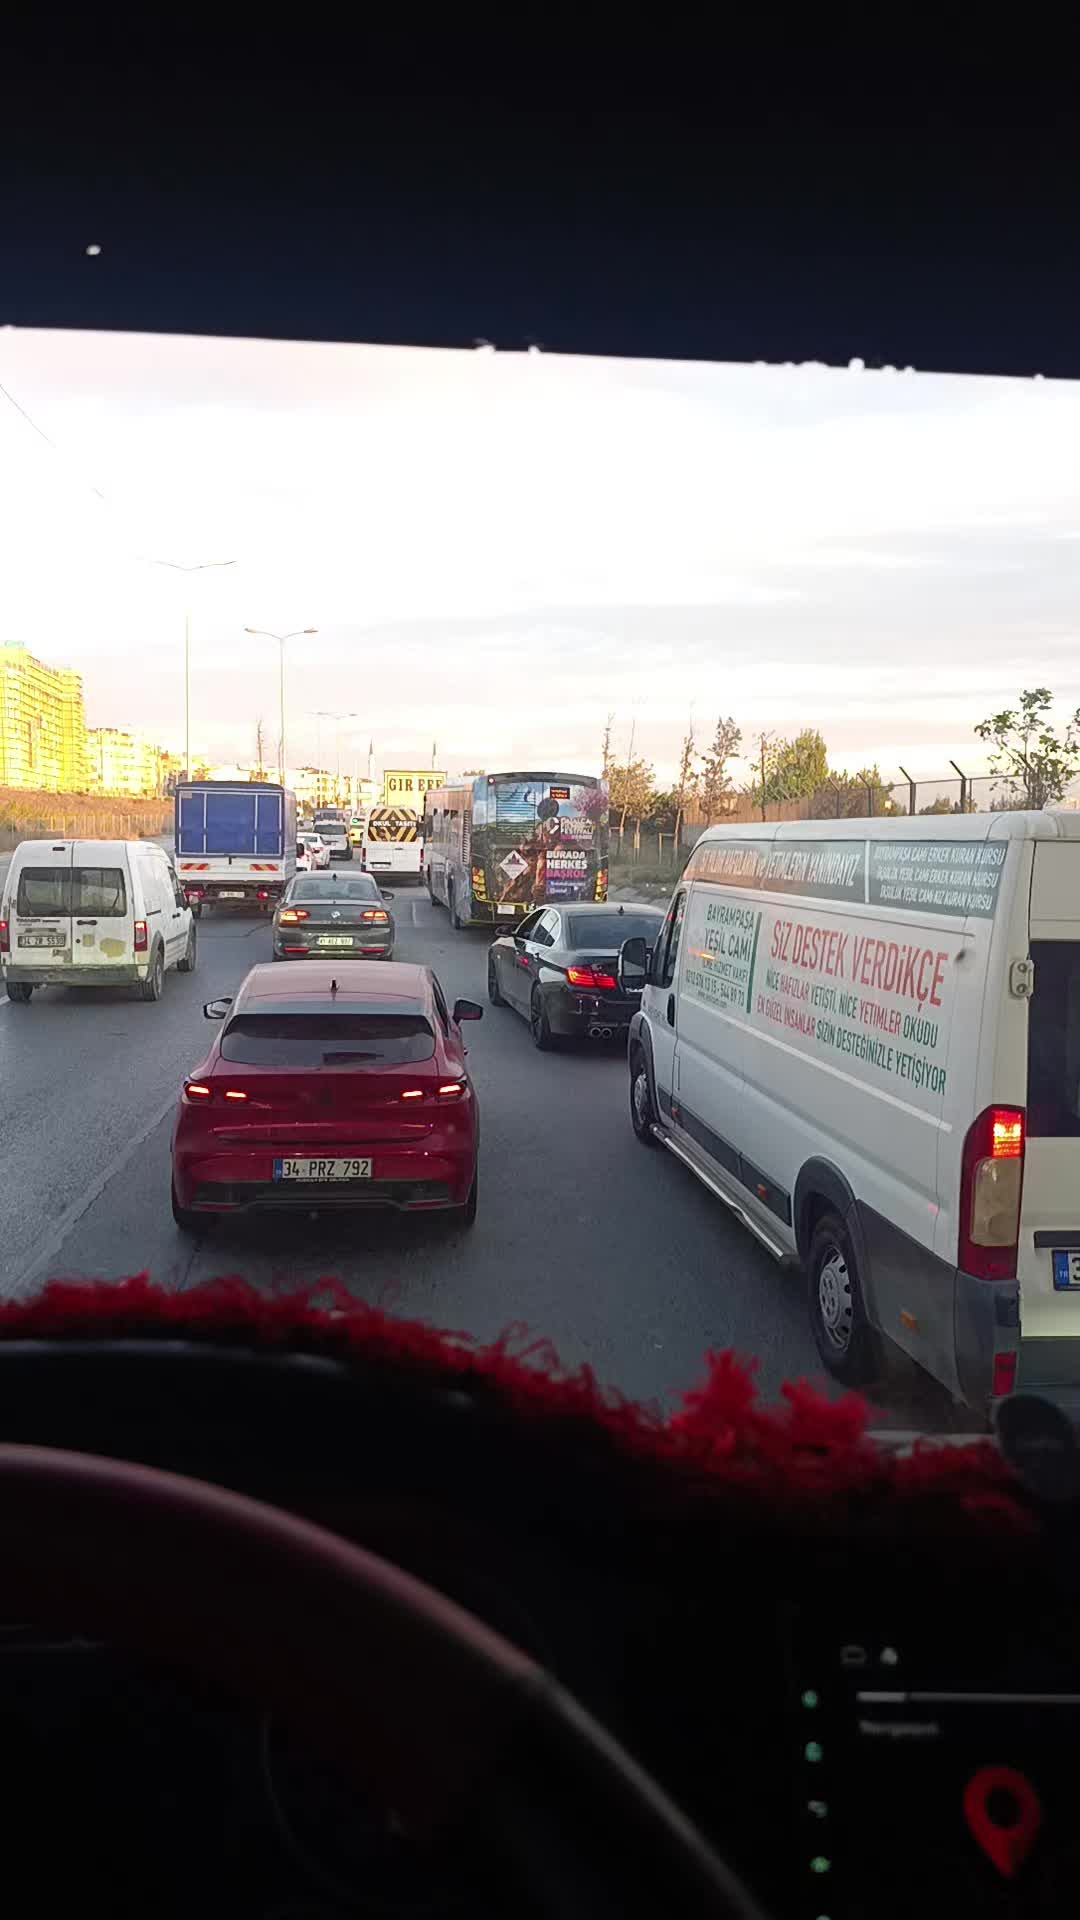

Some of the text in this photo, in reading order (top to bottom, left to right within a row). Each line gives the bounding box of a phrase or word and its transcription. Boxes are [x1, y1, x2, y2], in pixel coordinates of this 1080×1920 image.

[546, 850, 585, 859] BURADA
[975, 848, 1006, 866] KURSU
[546, 860, 588, 869] HERKES
[972, 871, 999, 889] KURSU
[707, 904, 755, 933] BAYRAMPAŞA
[792, 923, 849, 979] DESTEK
[903, 1014, 938, 1048] OKUDU
[895, 1050, 947, 1096] YETİŞİYOR
[284, 1160, 369, 1176] 34 PRZ 792
